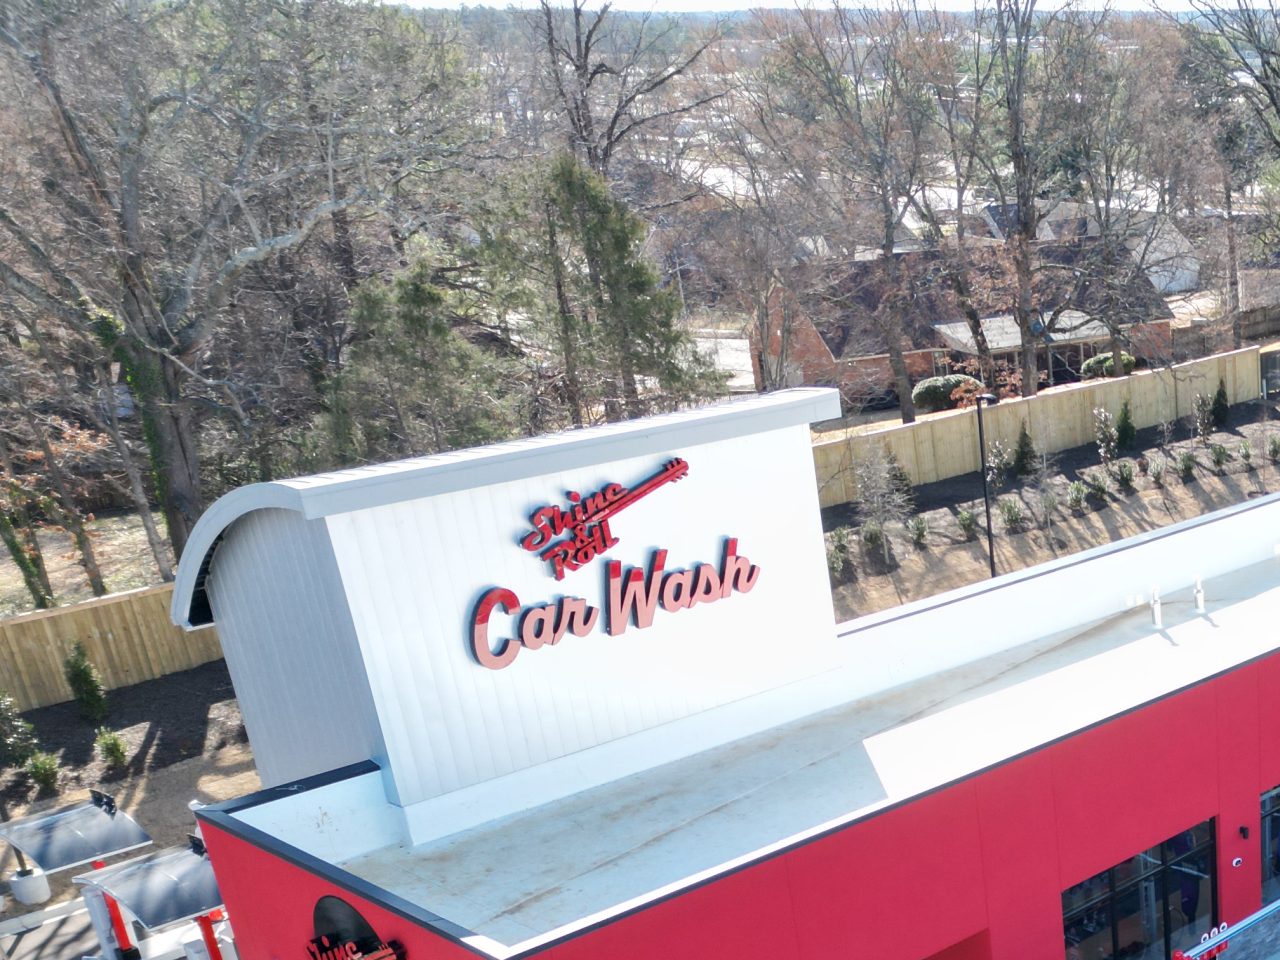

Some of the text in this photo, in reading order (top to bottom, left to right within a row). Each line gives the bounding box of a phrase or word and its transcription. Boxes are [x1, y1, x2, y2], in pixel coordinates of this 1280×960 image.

[519, 482, 630, 553] Shine
[541, 519, 620, 581] Roll
[472, 537, 761, 671] Car Wash
